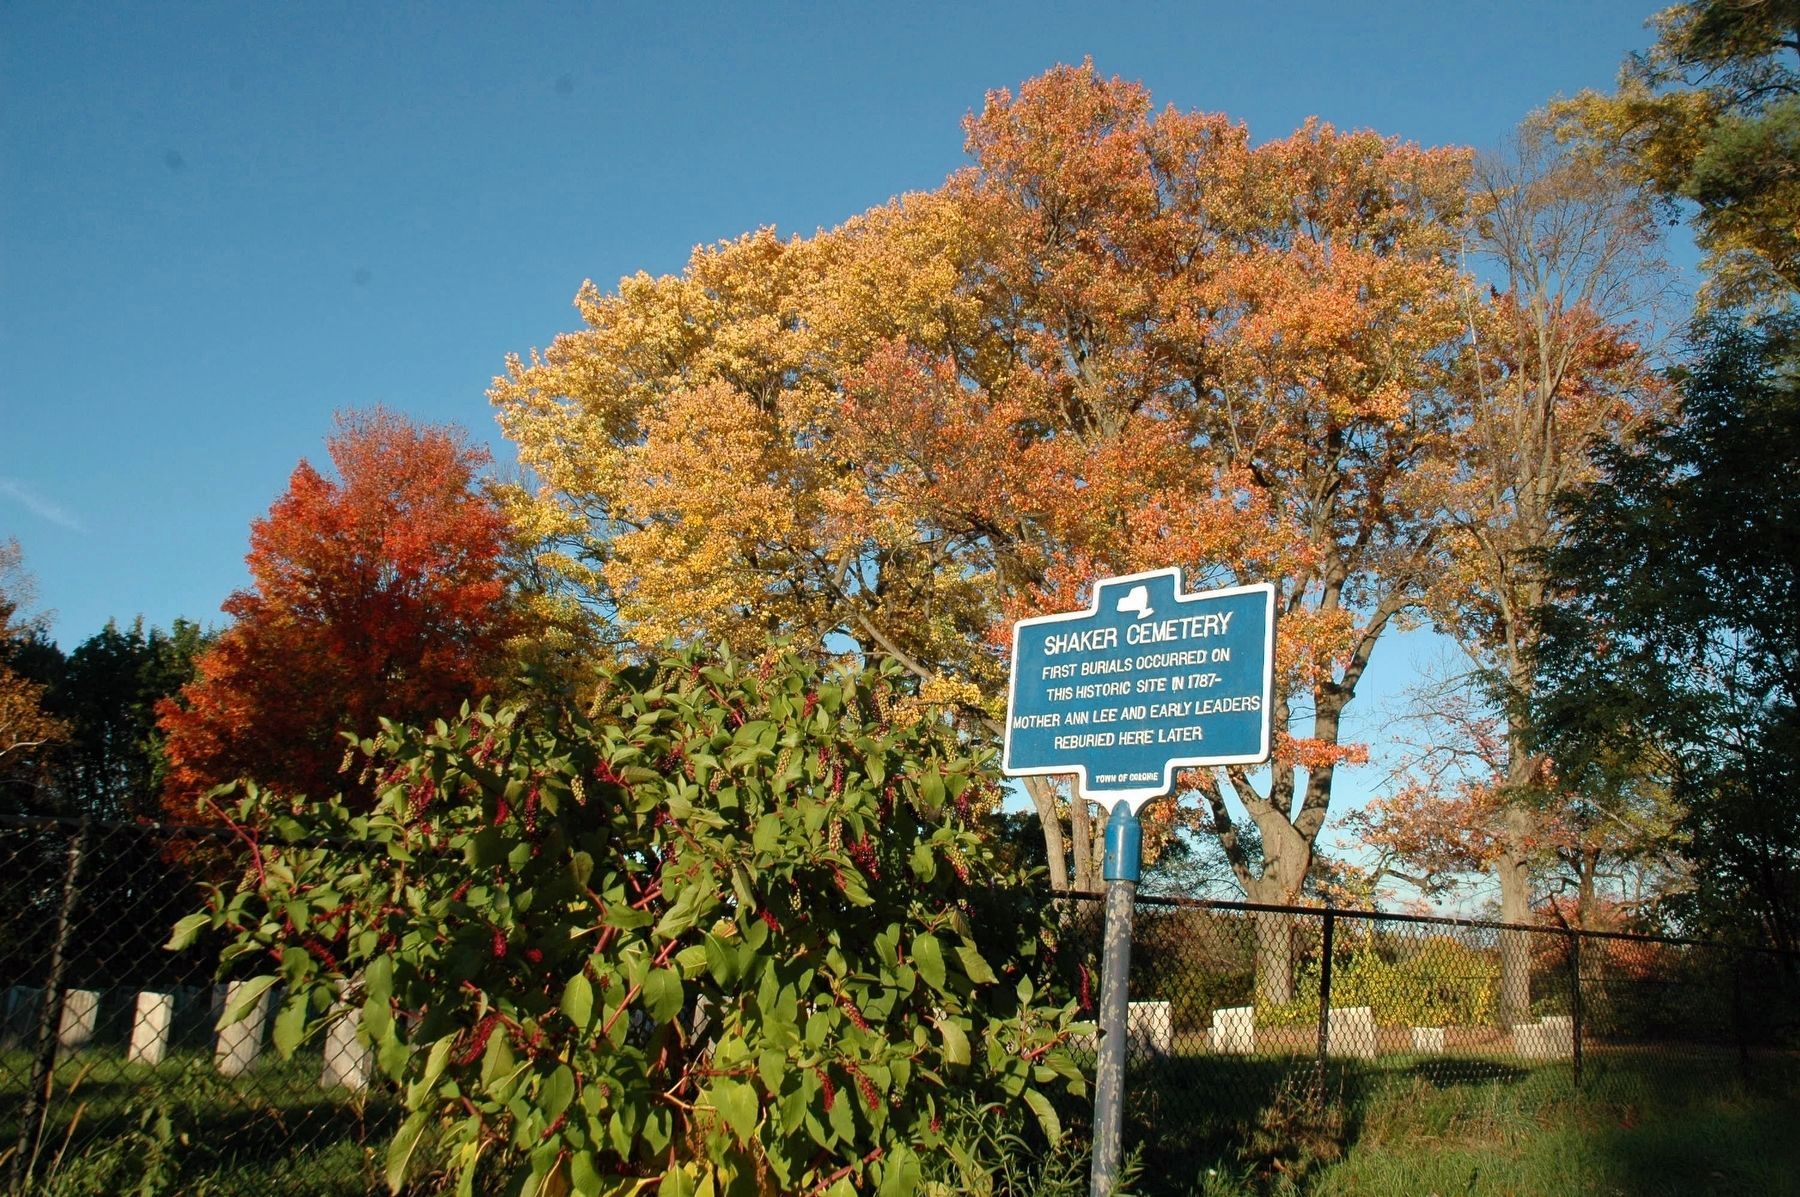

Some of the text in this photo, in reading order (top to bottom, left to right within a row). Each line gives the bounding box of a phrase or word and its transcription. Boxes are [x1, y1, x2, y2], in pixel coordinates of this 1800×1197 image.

[1044, 611, 1234, 655] SHAKER CEMETERY
[1042, 648, 1230, 680] FIRST BURIALS OCCURRED ON
[1047, 686, 1073, 702] THIS
[1076, 683, 1130, 699] HISTORIC
[1136, 678, 1166, 692] SITE
[1172, 676, 1184, 692] IN
[1013, 696, 1260, 729] MOTHER ANN LEE AND EARLY LEADERS
[1054, 726, 1203, 750] REBURIED HERE LATER
[1095, 774, 1116, 783] TOWN
[1118, 773, 1128, 782] OF
